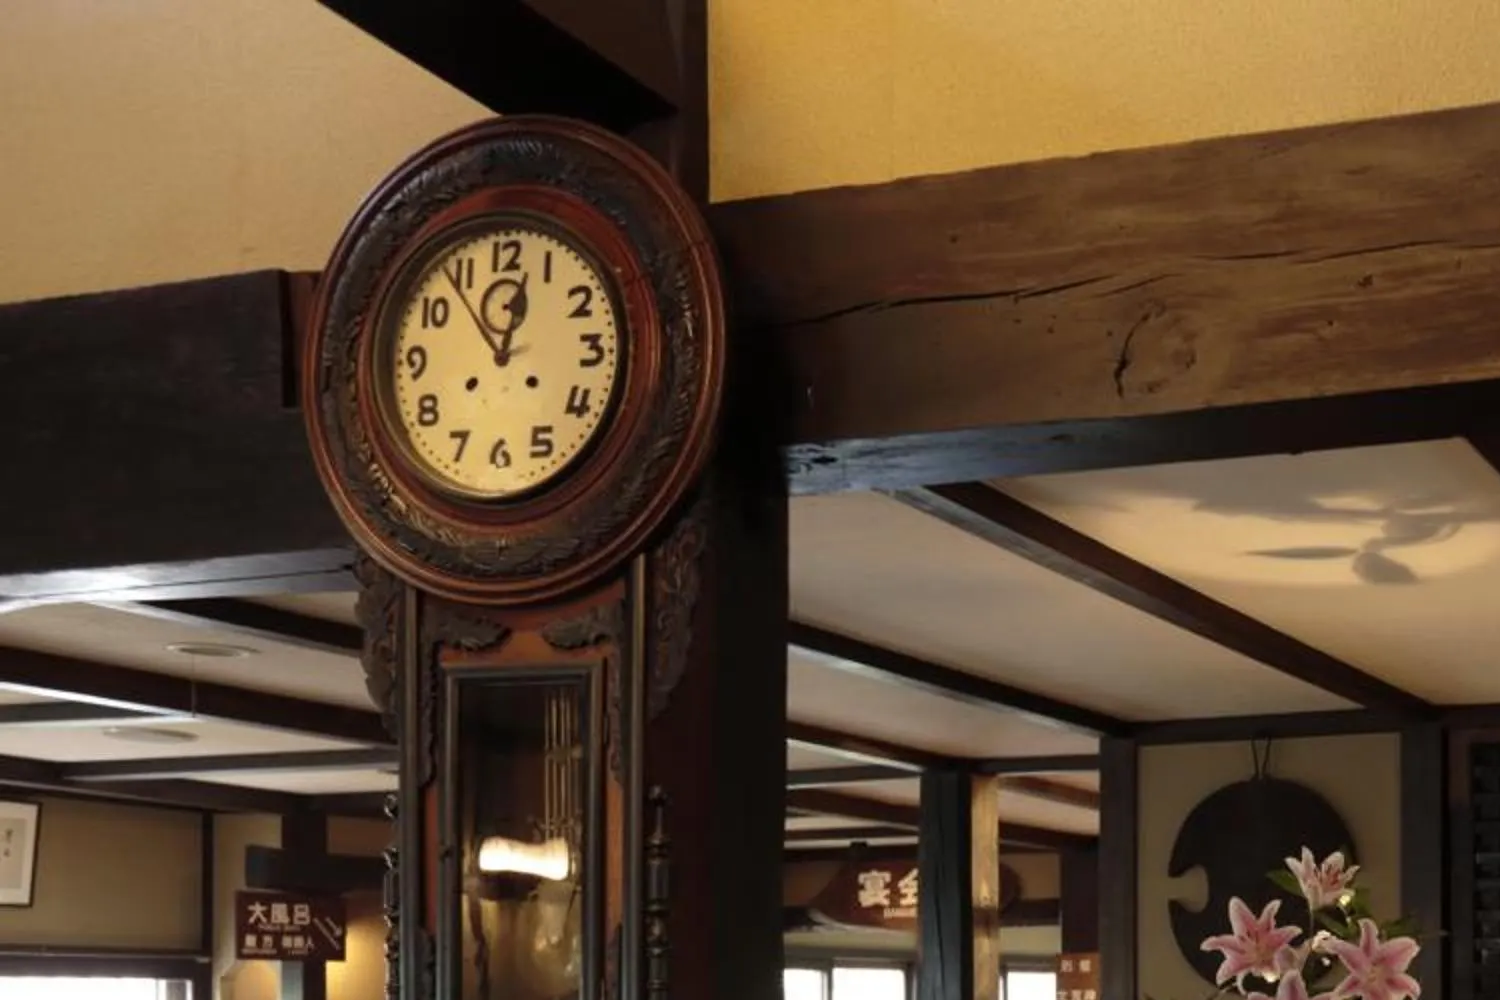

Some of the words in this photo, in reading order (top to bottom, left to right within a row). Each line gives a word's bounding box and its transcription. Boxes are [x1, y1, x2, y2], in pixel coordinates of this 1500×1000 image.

[491, 240, 522, 273] 12
[543, 251, 551, 283] 1
[455, 258, 473, 290] 11
[421, 296, 449, 329] 10
[567, 286, 592, 319] 2
[407, 346, 427, 380] 9
[579, 333, 605, 368] 3
[417, 394, 440, 427] 8
[565, 385, 591, 417] 4
[450, 430, 471, 463] 7
[489, 439, 511, 469] 6
[529, 426, 554, 458] 5
